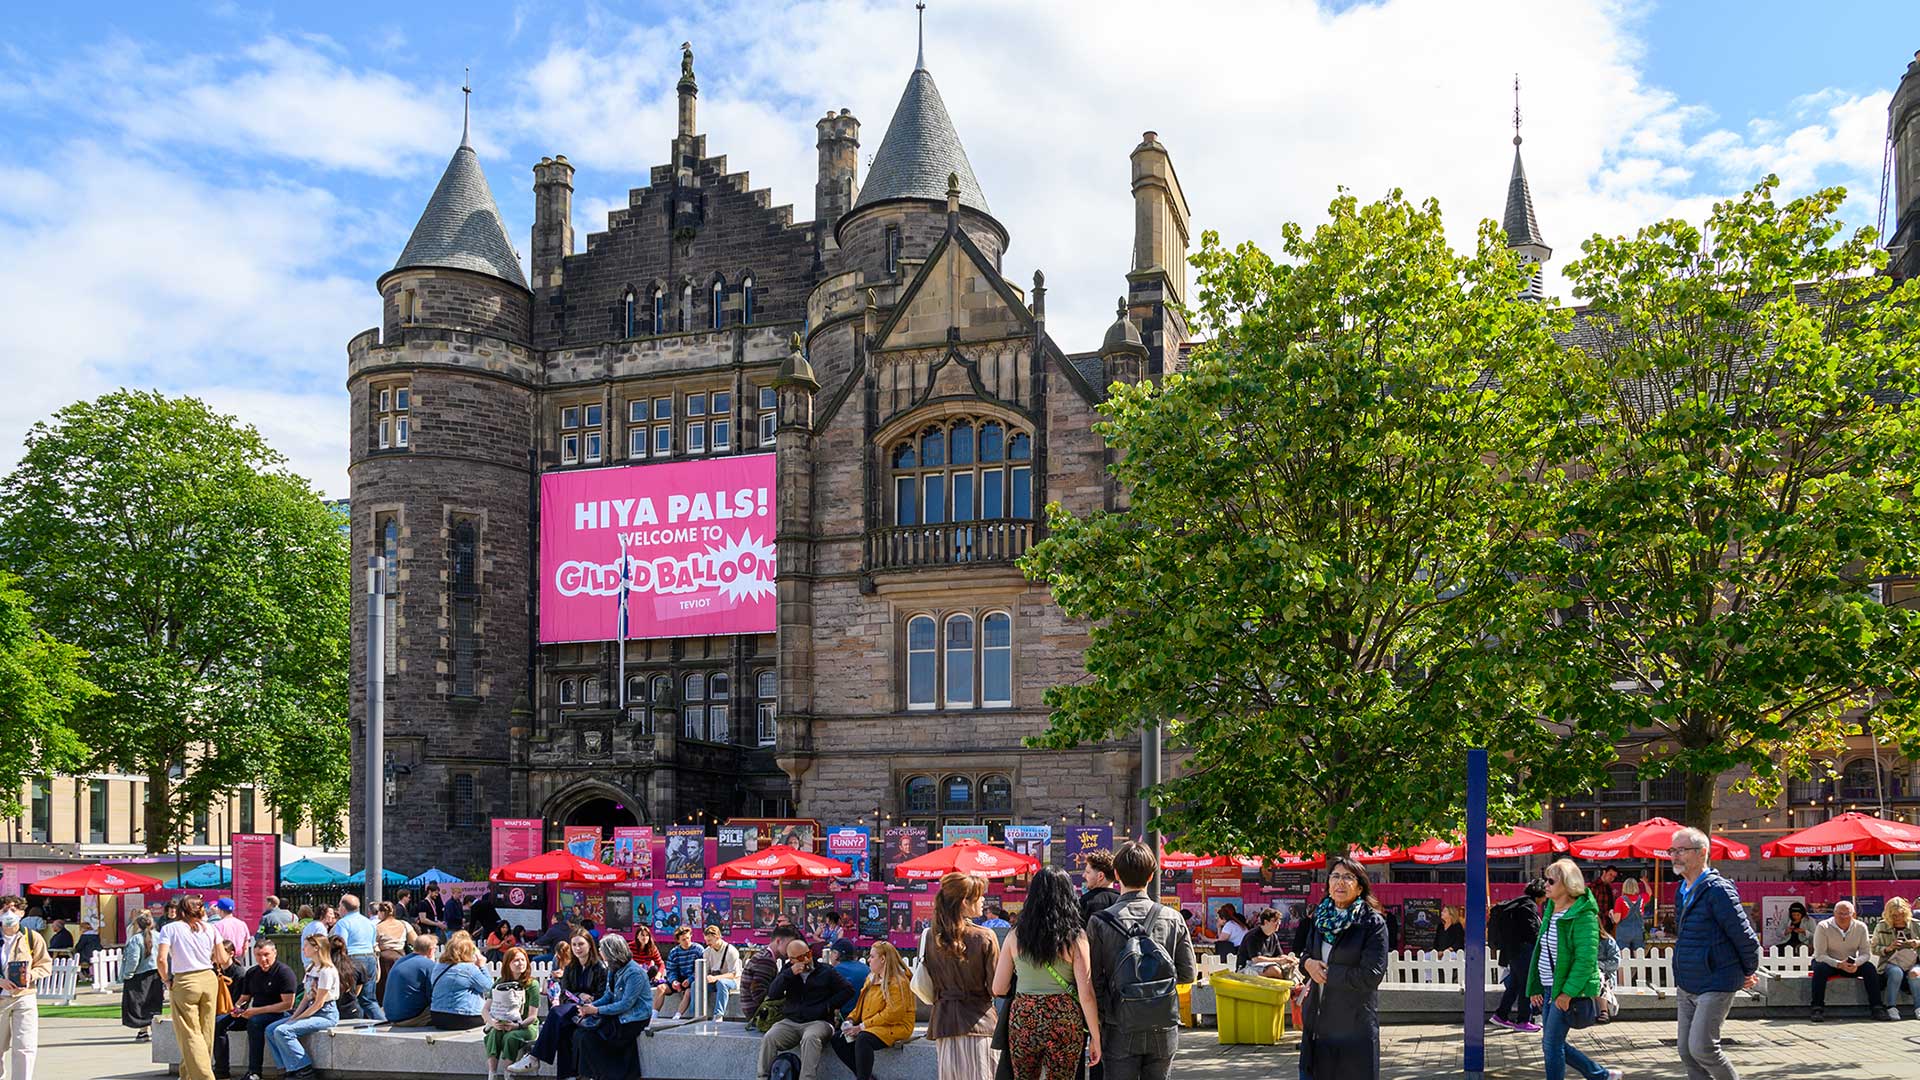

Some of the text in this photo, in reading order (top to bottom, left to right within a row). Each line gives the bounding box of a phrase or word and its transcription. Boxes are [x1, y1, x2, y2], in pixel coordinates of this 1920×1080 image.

[575, 487, 768, 530] HIYA PALS!
[617, 525, 723, 547] WELCOME TO
[655, 551, 776, 588] BALLOON
[679, 598, 711, 610] TEVIOT
[719, 834, 743, 843] PILE
[832, 837, 864, 847] FUNNY?
